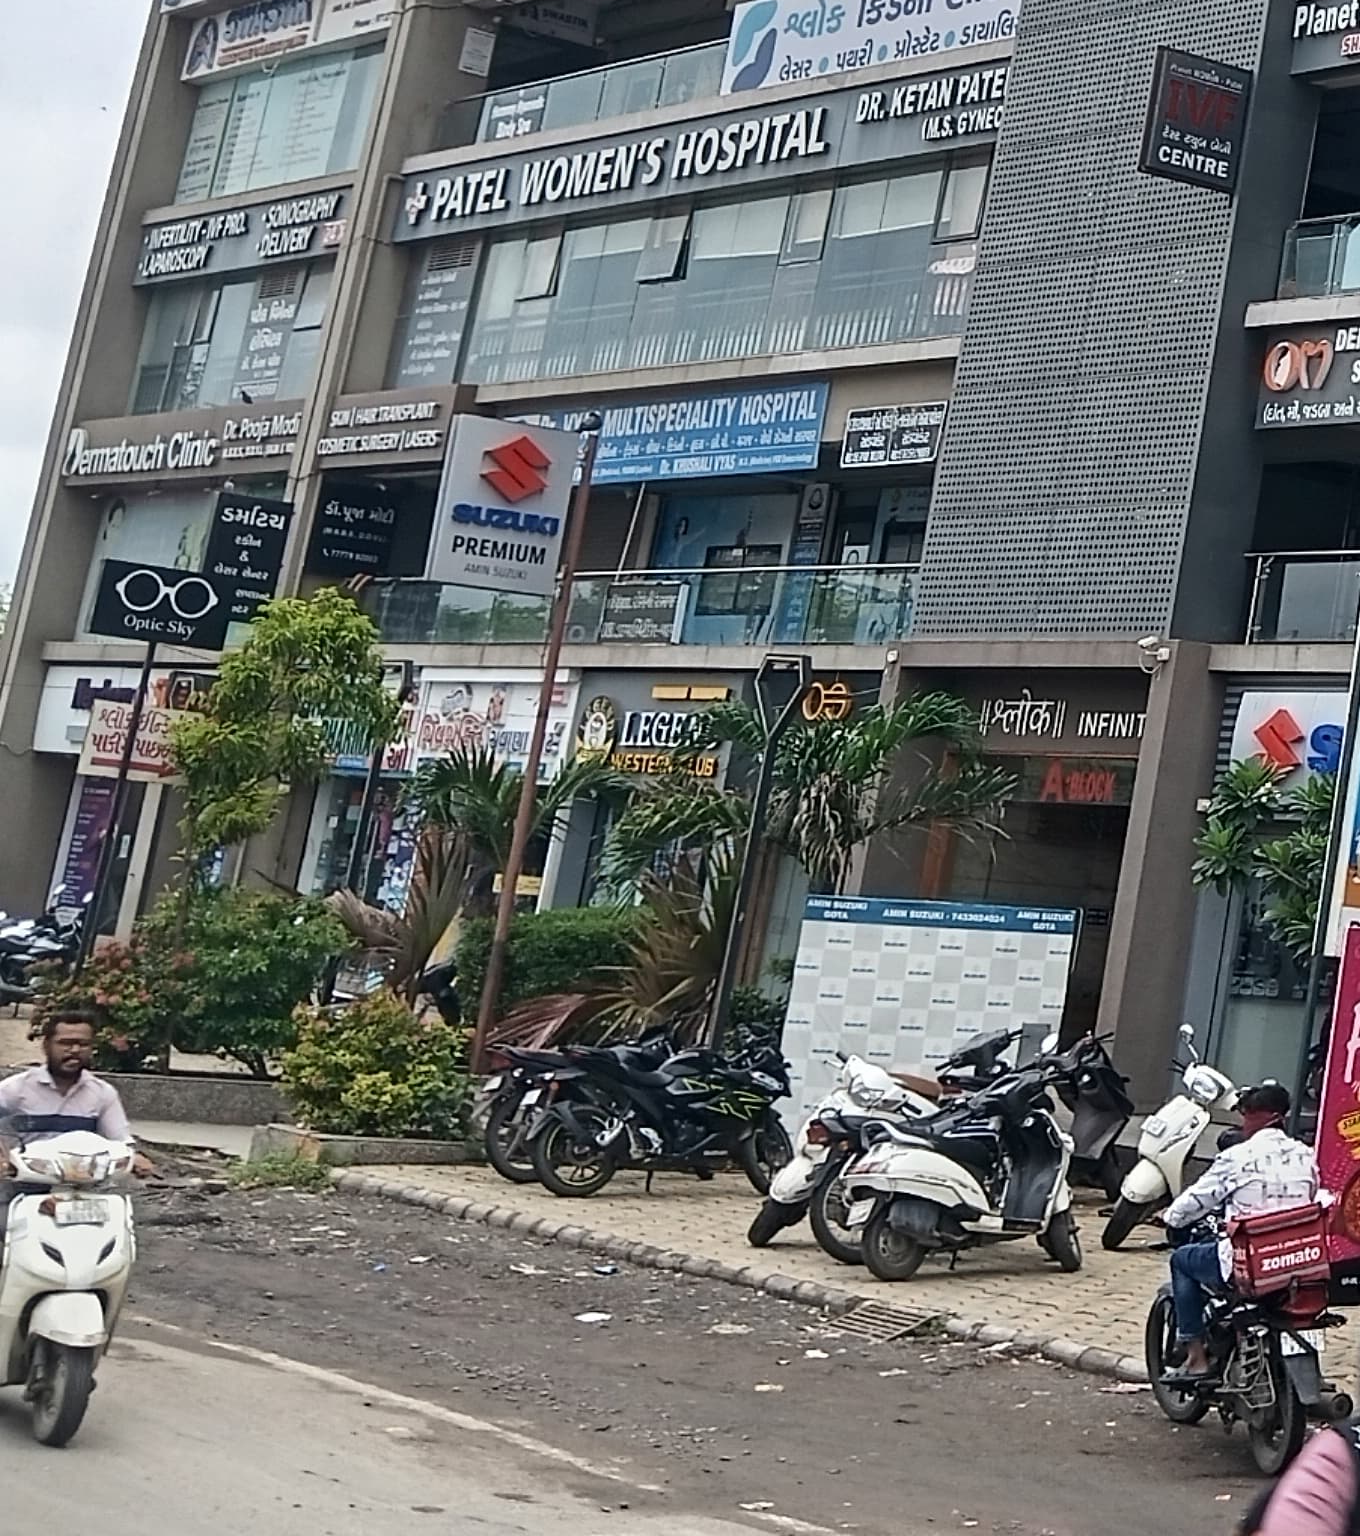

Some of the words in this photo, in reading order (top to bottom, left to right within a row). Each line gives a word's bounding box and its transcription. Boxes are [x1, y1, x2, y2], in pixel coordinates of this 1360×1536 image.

[855, 92, 885, 124] DR.
[889, 79, 950, 116] KETAN
[430, 167, 509, 222] PATEL
[518, 138, 665, 207] WOMEN'S
[670, 107, 831, 182] HOSPITAL
[1158, 146, 1229, 178] CENTRE
[257, 224, 316, 258] DELIVERY
[602, 397, 738, 438] MULTISPECIALITY
[738, 389, 818, 423] HOSPITAL
[451, 503, 561, 538] SUZUKI
[451, 535, 548, 566] PREMIUM
[124, 612, 164, 633] Optic
[166, 619, 196, 640] Sky
[824, 911, 848, 920] GOTA
[1032, 922, 1056, 931] GOTA
[1261, 1246, 1322, 1272] zomato
